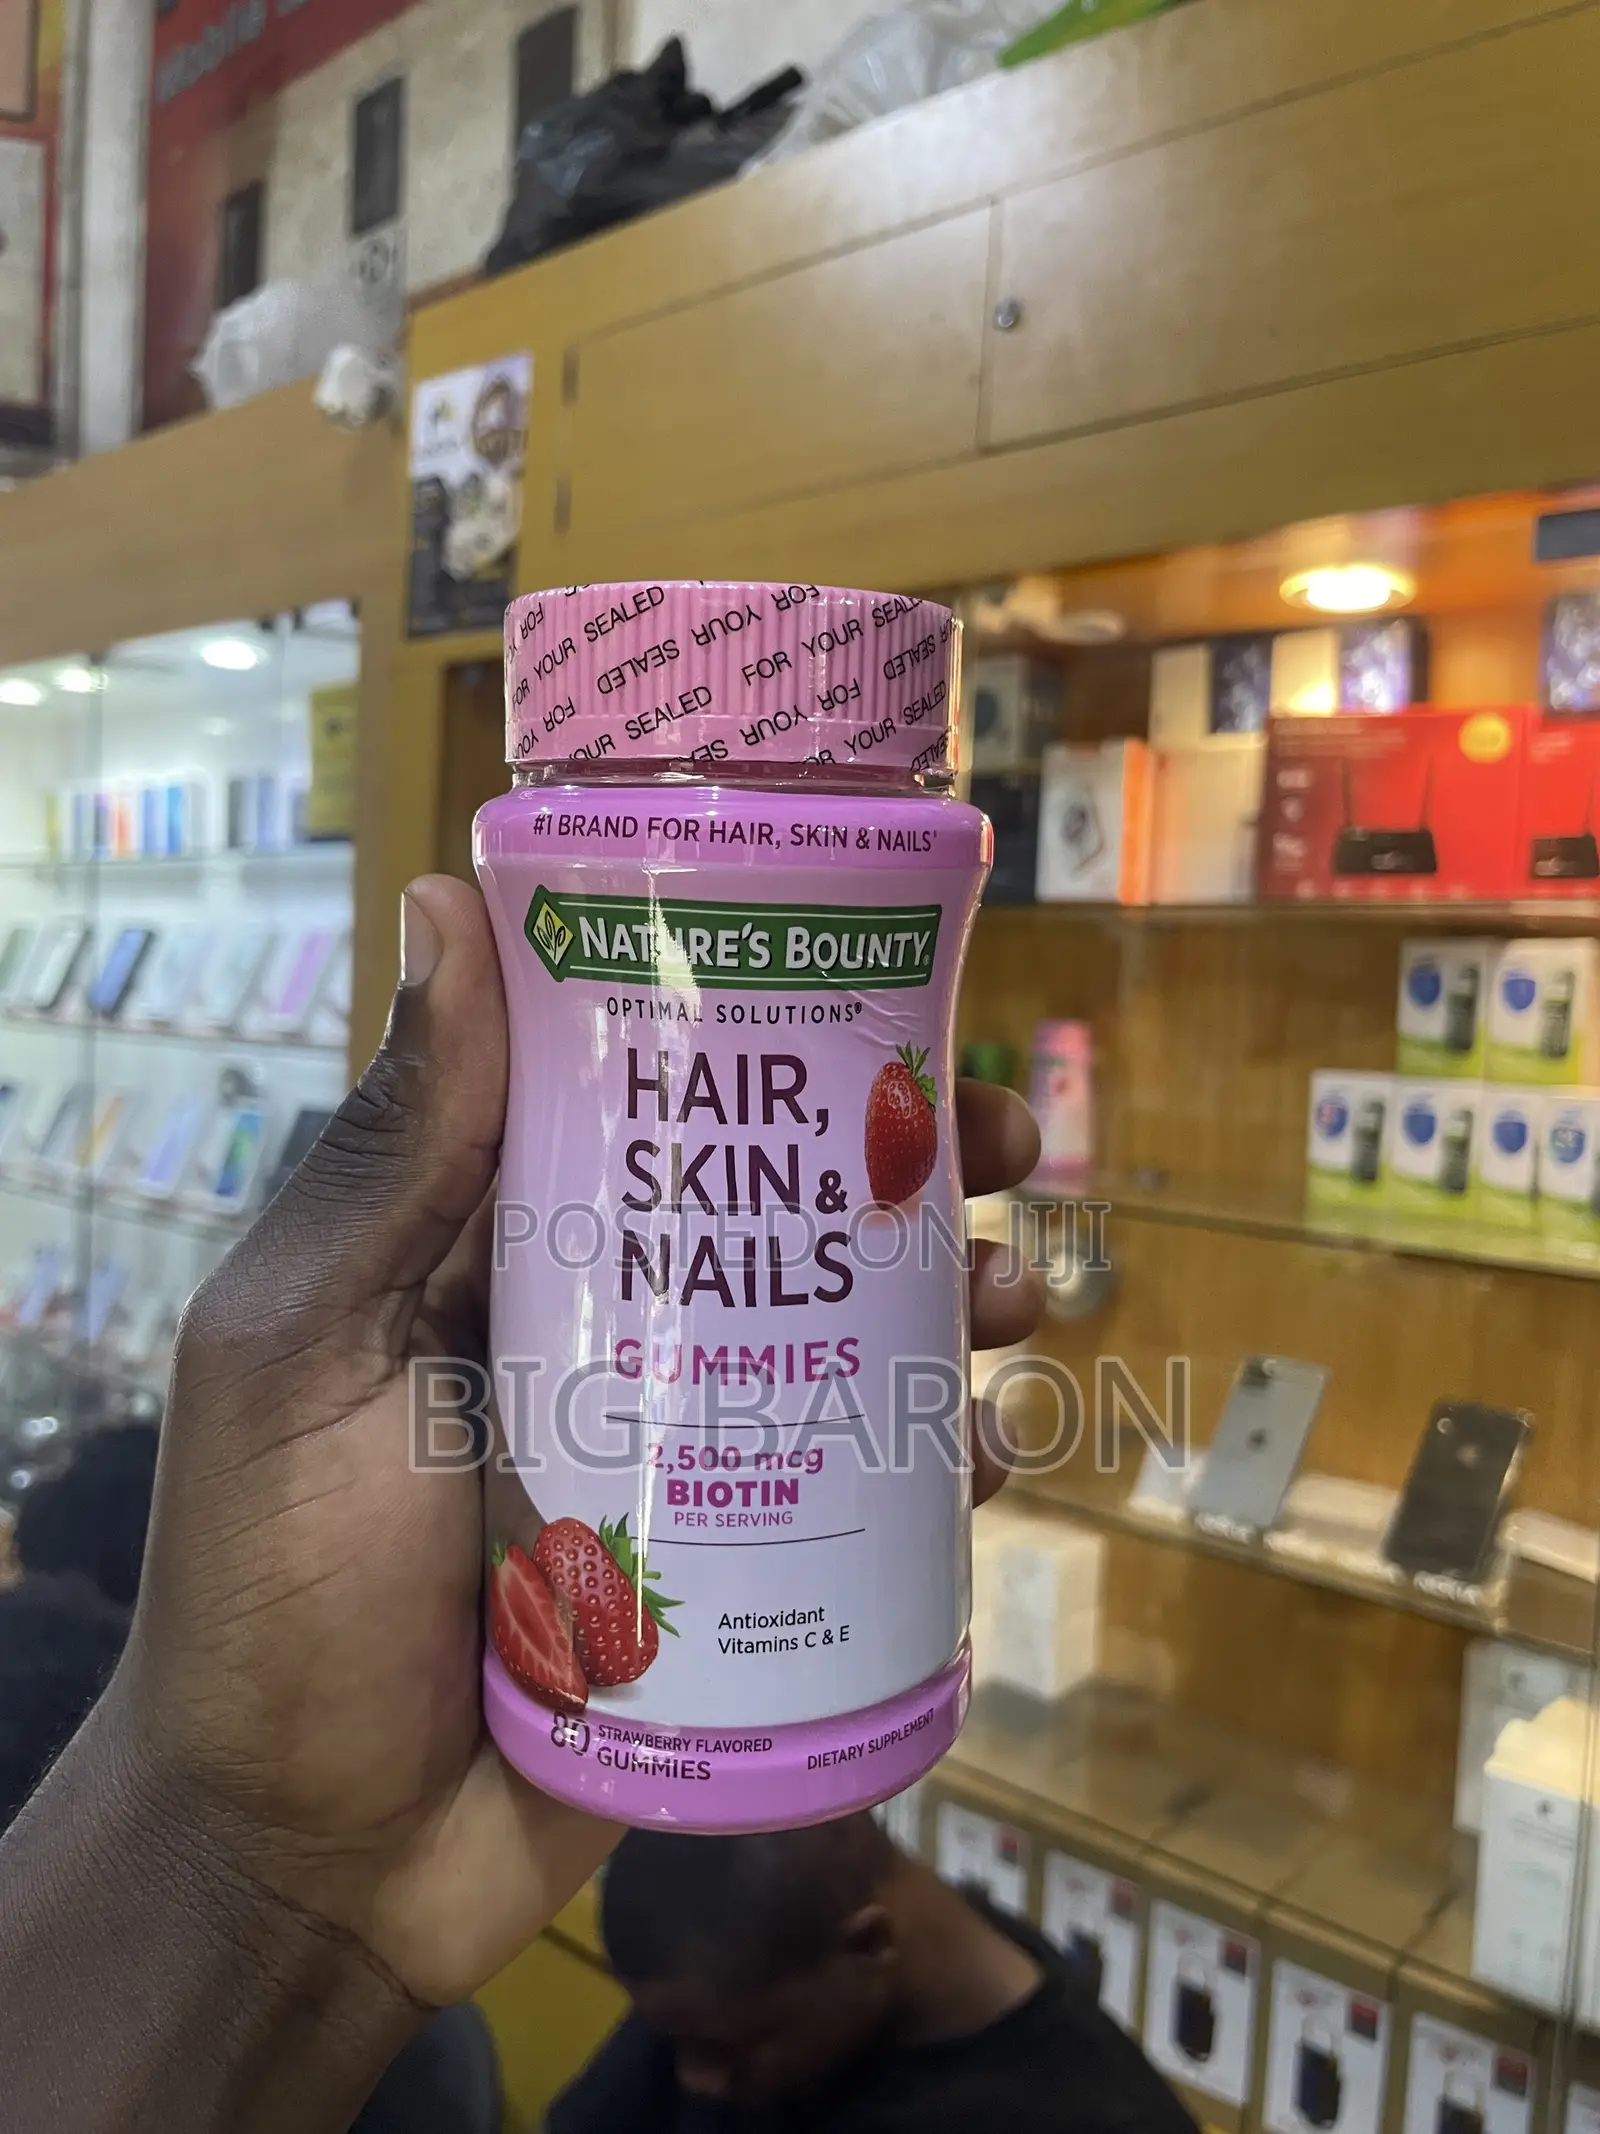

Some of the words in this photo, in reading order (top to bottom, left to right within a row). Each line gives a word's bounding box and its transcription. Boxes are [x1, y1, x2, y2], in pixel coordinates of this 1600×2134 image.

[771, 584, 820, 611] FOR
[533, 637, 577, 680] YOUR
[584, 586, 665, 642] SEALED
[691, 604, 761, 646] YOUR
[597, 639, 680, 694] SEALED
[883, 634, 936, 681] SEALED
[569, 733, 617, 761] OUR
[624, 686, 712, 740] SEALED
[741, 651, 792, 686] FOR
[801, 619, 864, 657] YOUR
[817, 677, 861, 711] FOR
[543, 697, 576, 732] FOR
[739, 704, 807, 746] YOUR
[844, 717, 897, 755] YOUR
[903, 680, 947, 726] SEALED
[533, 814, 552, 836] #1
[558, 815, 638, 839] BRAND
[647, 817, 699, 842] FOR
[709, 820, 780, 850] HAIR,
[790, 823, 848, 849] SKIN
[855, 827, 870, 850] &
[607, 997, 702, 1022] OPTIMAL
[626, 1047, 831, 1137] HAIR,
[621, 1139, 801, 1216] SKIN
[815, 1169, 848, 1214] &
[621, 1230, 854, 1308] NAILS
[614, 1337, 860, 1386] GUMMIES
[648, 1443, 741, 1475] 2,500
[754, 1448, 824, 1474] mcg
[667, 1478, 799, 1508] BIOTIN
[674, 1511, 708, 1527] PER
[715, 1511, 793, 1527] SERVING
[717, 1633, 799, 1655] Vitamins
[804, 1631, 817, 1648] C
[821, 1628, 834, 1646] &
[839, 1624, 850, 1642] E
[718, 1606, 825, 1631] Antioxidant
[550, 1711, 590, 1756] 80
[598, 1724, 692, 1752] STRAWBERRY
[695, 1738, 773, 1753] FLAVORED
[807, 1743, 865, 1770] DIETARY
[868, 1707, 935, 1754] SUPPLEMENT
[597, 1746, 711, 1780] GUMMIES
